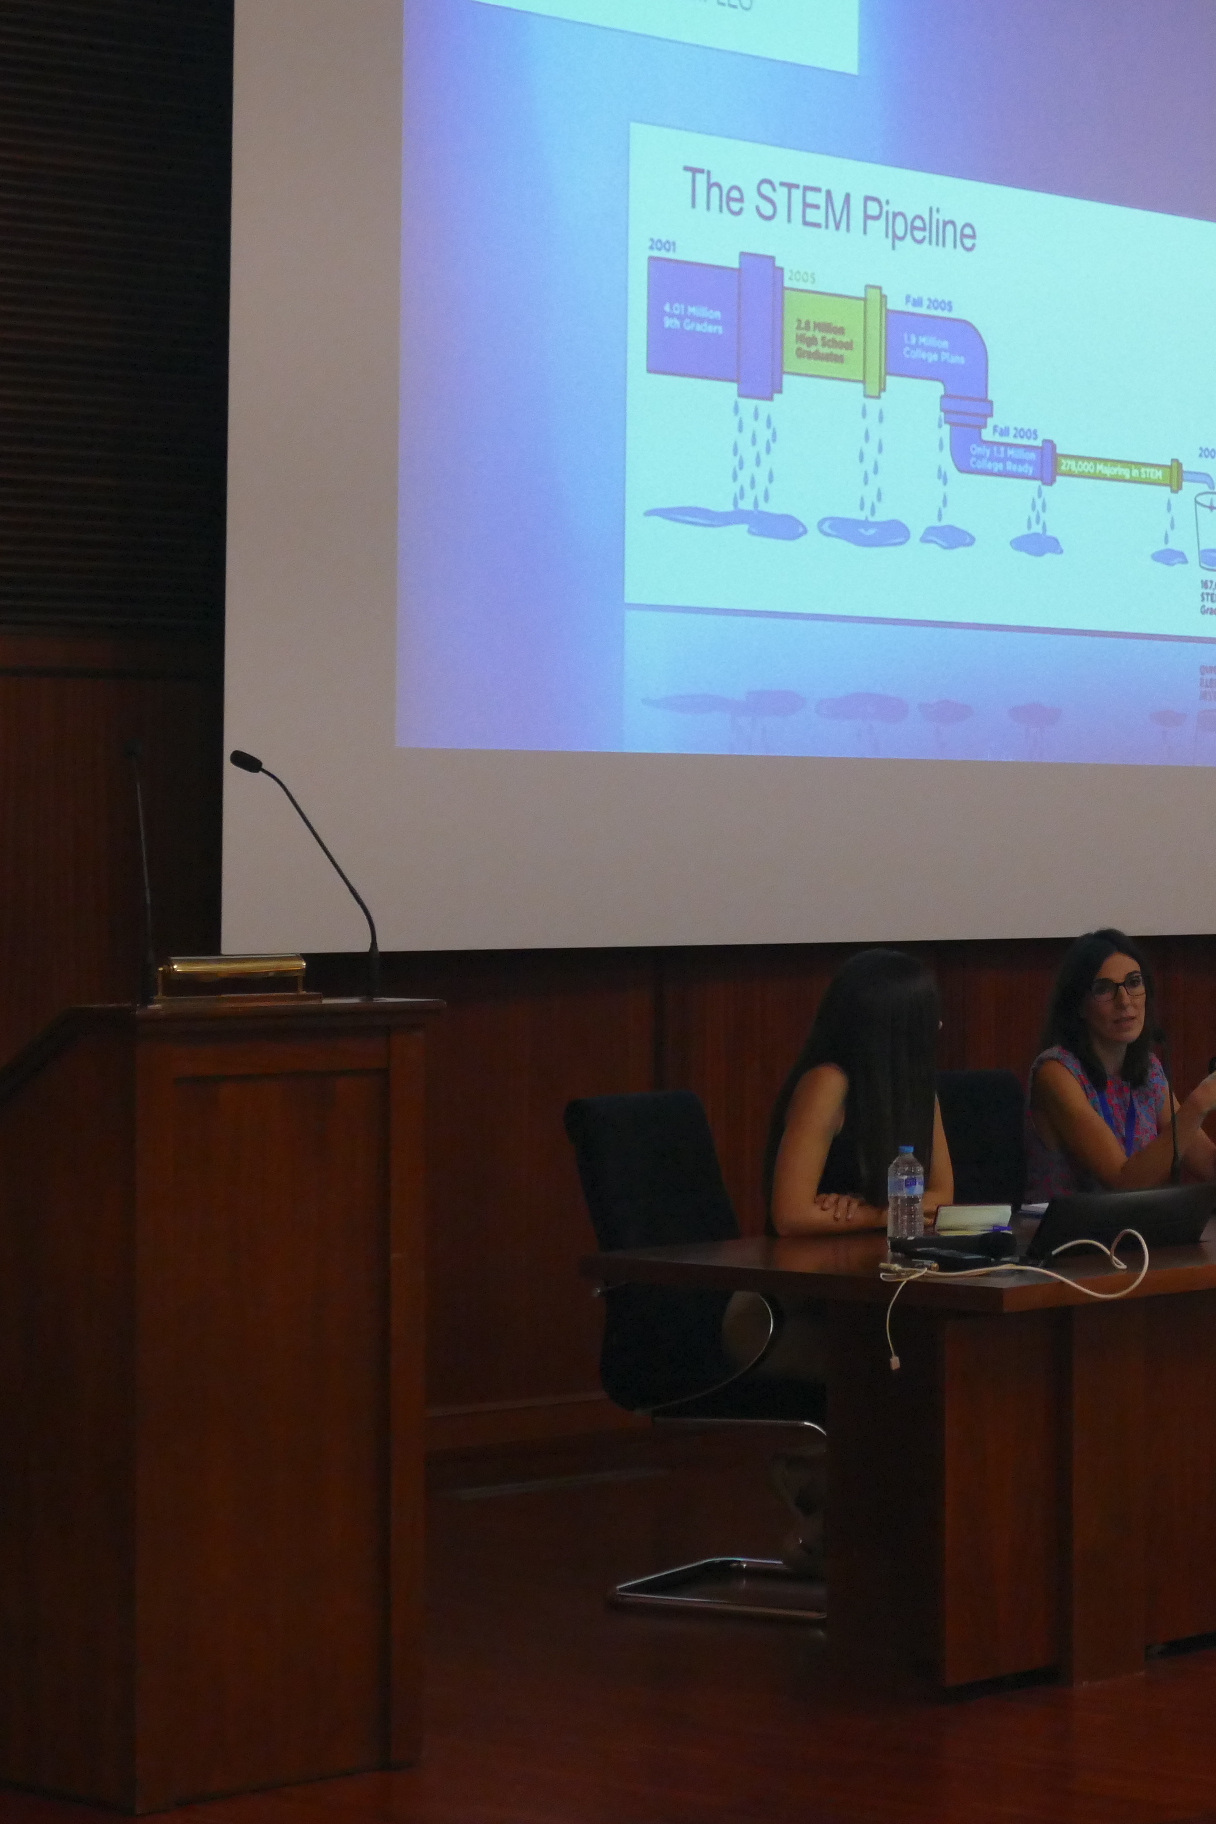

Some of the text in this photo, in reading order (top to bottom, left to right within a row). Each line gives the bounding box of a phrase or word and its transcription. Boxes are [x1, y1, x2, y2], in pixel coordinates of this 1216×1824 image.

[683, 165, 977, 253] The STEM Pipeline
[648, 237, 677, 253] 2001
[787, 269, 816, 285] 2005
[904, 293, 953, 313] Fall 2005
[683, 317, 724, 335] Graders
[992, 424, 1039, 441] Fall 2005
[1140, 467, 1164, 481] STEM
